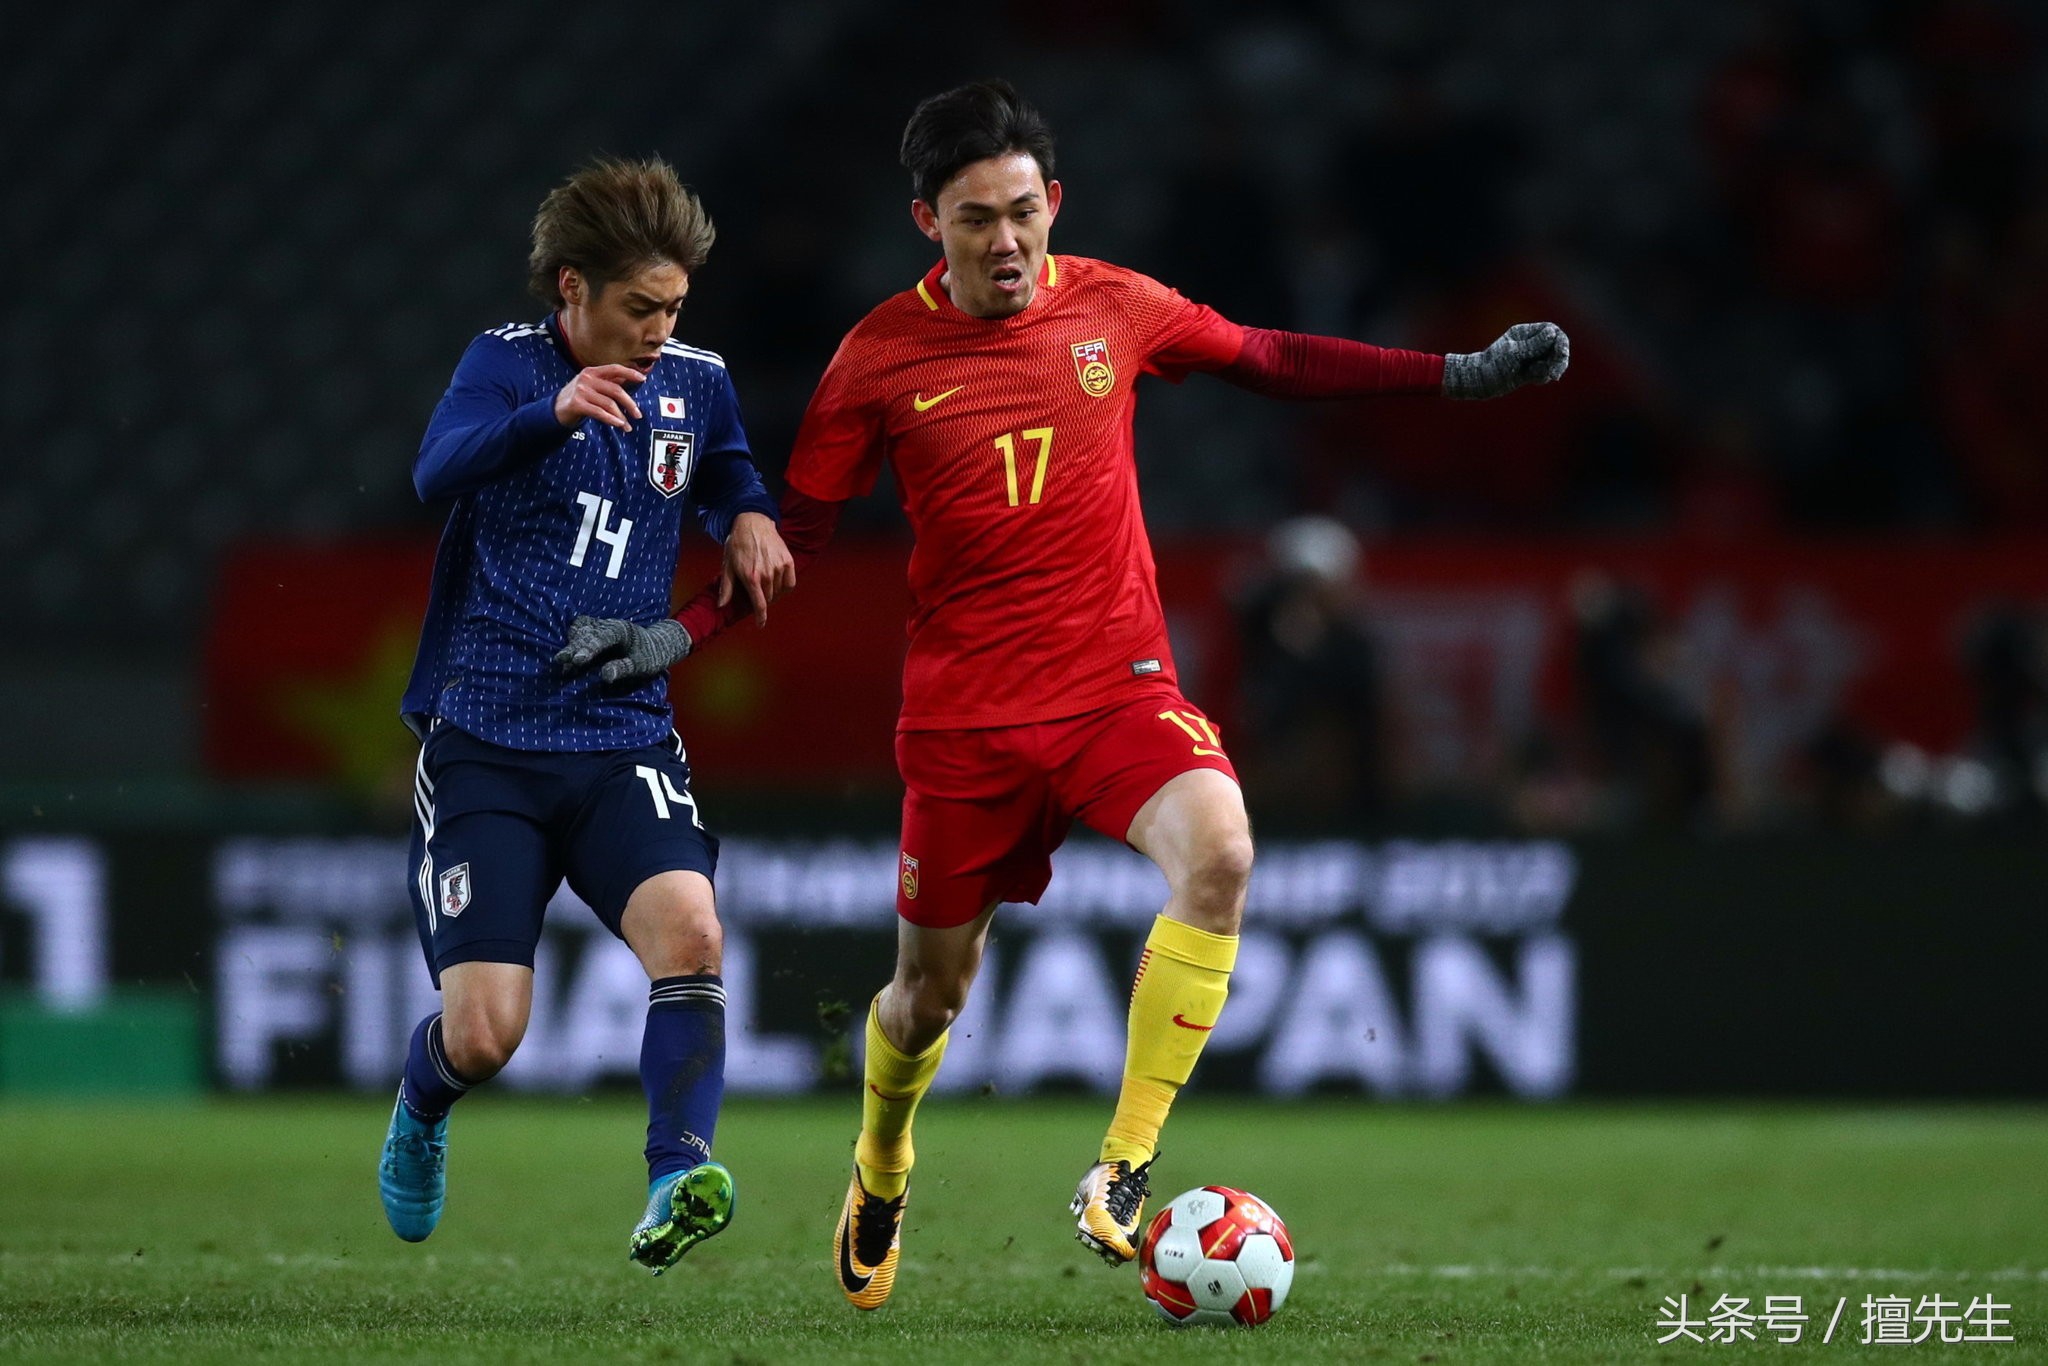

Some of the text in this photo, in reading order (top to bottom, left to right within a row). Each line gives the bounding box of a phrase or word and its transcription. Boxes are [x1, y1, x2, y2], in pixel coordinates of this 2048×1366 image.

[1074, 342, 1104, 357] CFA
[994, 426, 1054, 507] 17
[569, 491, 633, 579] 14
[1157, 710, 1220, 748] 17
[636, 765, 705, 831] 14
